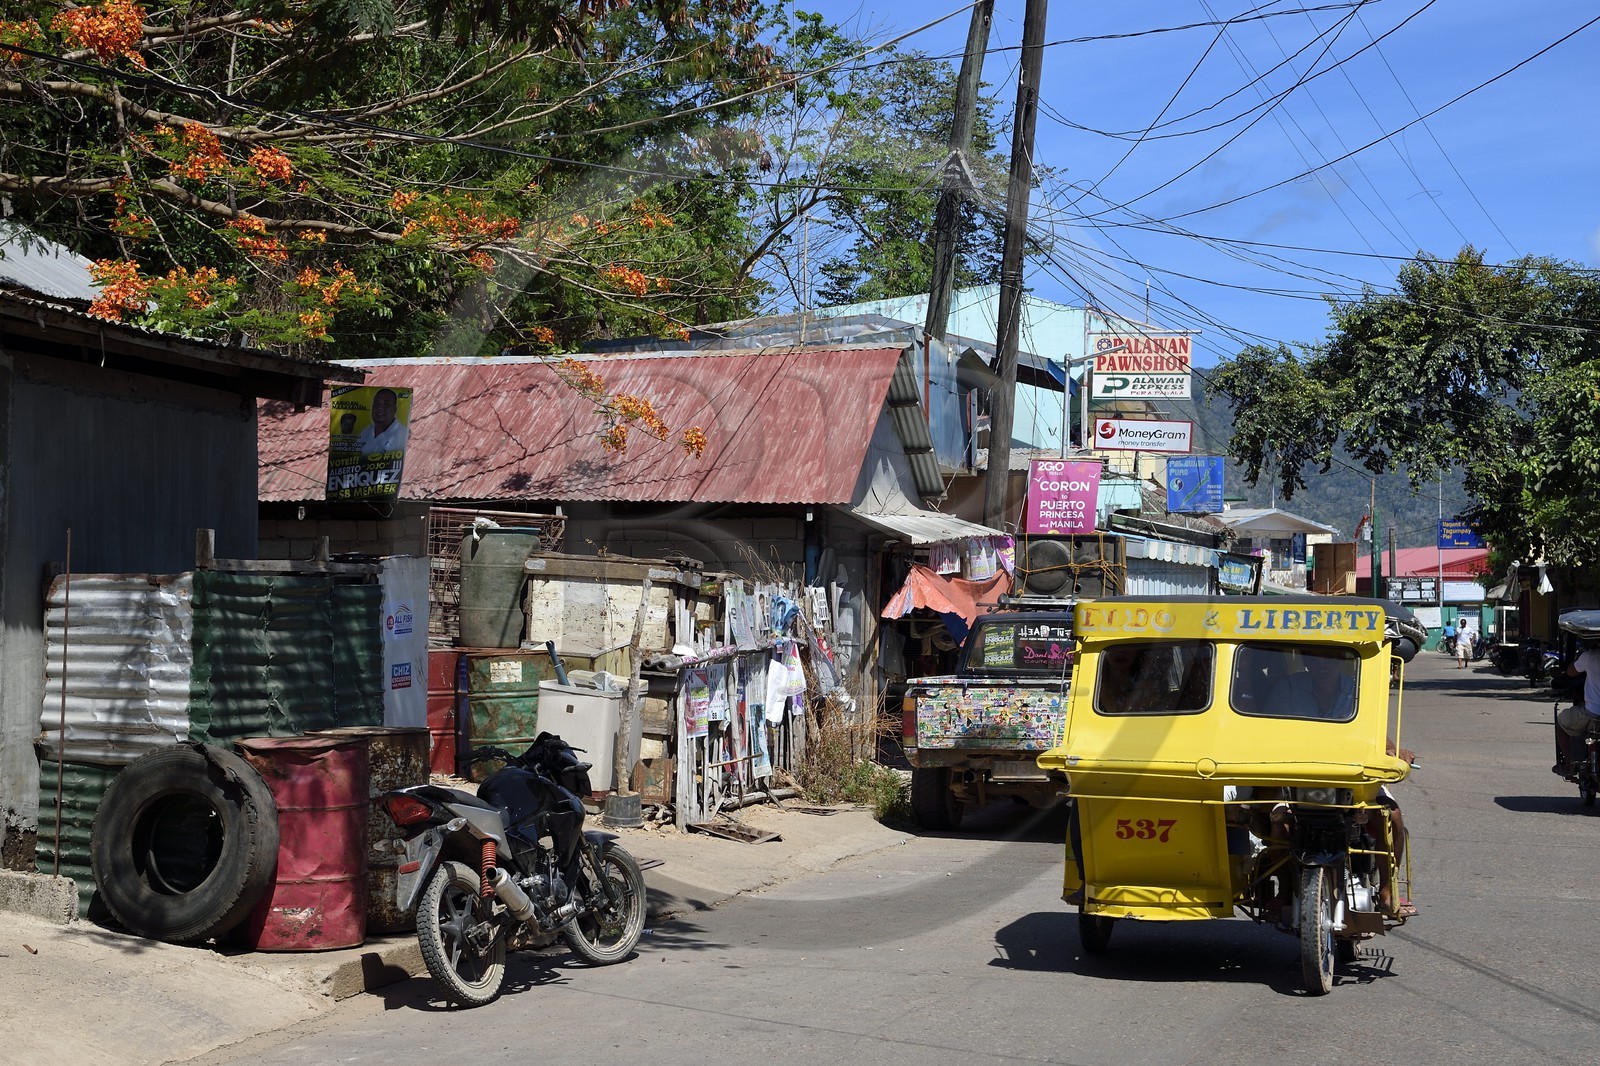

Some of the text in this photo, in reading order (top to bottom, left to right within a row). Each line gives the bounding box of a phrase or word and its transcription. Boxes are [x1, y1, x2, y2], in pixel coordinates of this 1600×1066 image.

[1113, 338, 1189, 354] PALAWAN
[1096, 355, 1189, 371] PAWNSHOP
[1118, 428, 1186, 440] MoneyGram
[329, 456, 360, 467] VOTE!!!
[1037, 461, 1065, 471] 2GO
[329, 465, 361, 477] ALBERTO
[328, 469, 402, 492] ENRIQUEZ
[1040, 481, 1090, 491] CORON
[338, 488, 351, 500] SB
[353, 483, 397, 498] MEMBER
[1040, 501, 1086, 510] PUERTO
[1237, 608, 1381, 632] LIBERTY
[393, 665, 410, 676] CHIZ
[1115, 818, 1178, 843] 537
